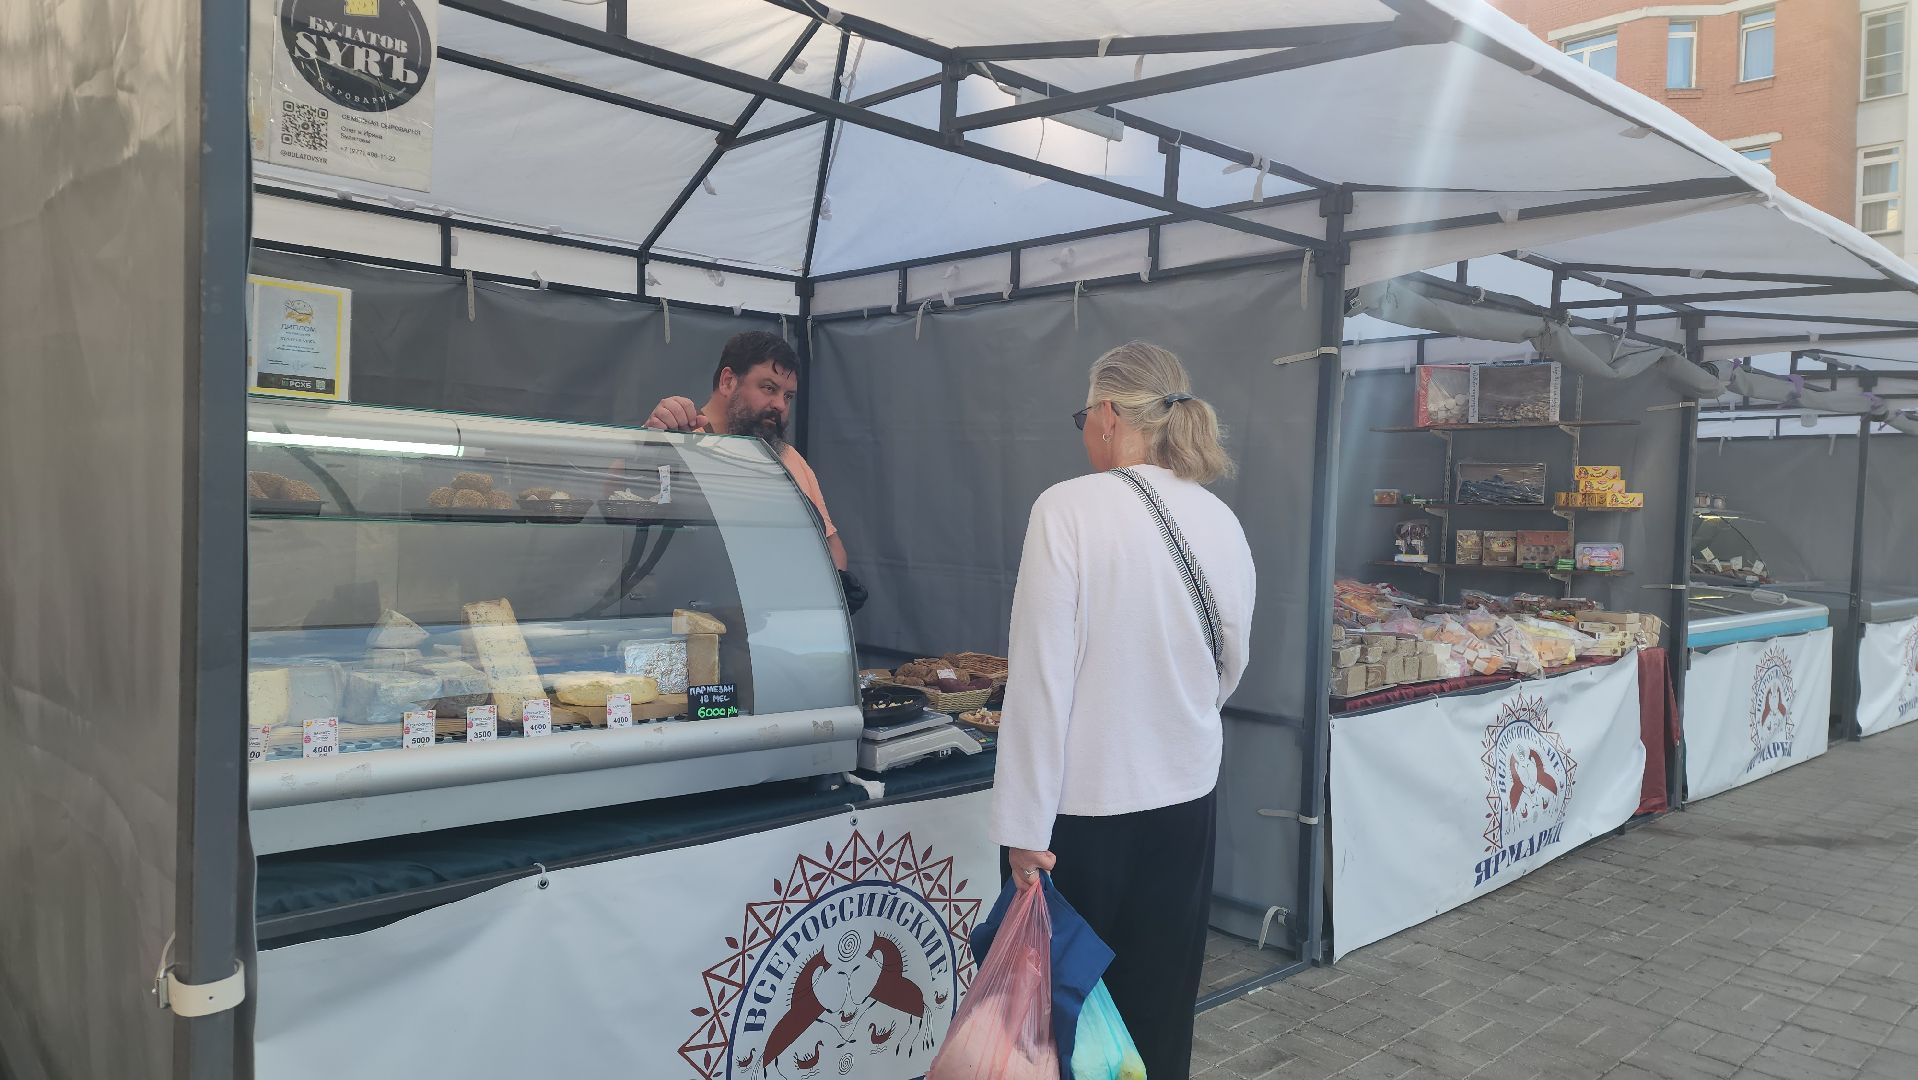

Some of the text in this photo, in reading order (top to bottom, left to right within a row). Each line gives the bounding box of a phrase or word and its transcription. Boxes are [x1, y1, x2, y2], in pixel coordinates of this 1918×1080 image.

[308, 15, 408, 53] БУЛАТОВ
[289, 380, 312, 389] РСХБ
[690, 685, 734, 695] ПАРМЕЗАН
[700, 695, 709, 703] 18
[698, 707, 725, 718] 6000
[613, 716, 629, 724] 4000
[530, 723, 547, 731] 4000
[474, 730, 492, 739] 3500
[411, 736, 431, 745] 5000
[312, 745, 333, 754] 4000
[249, 750, 261, 759] 00
[742, 889, 949, 1034] ВСЕРОССИЙСКИЕ
